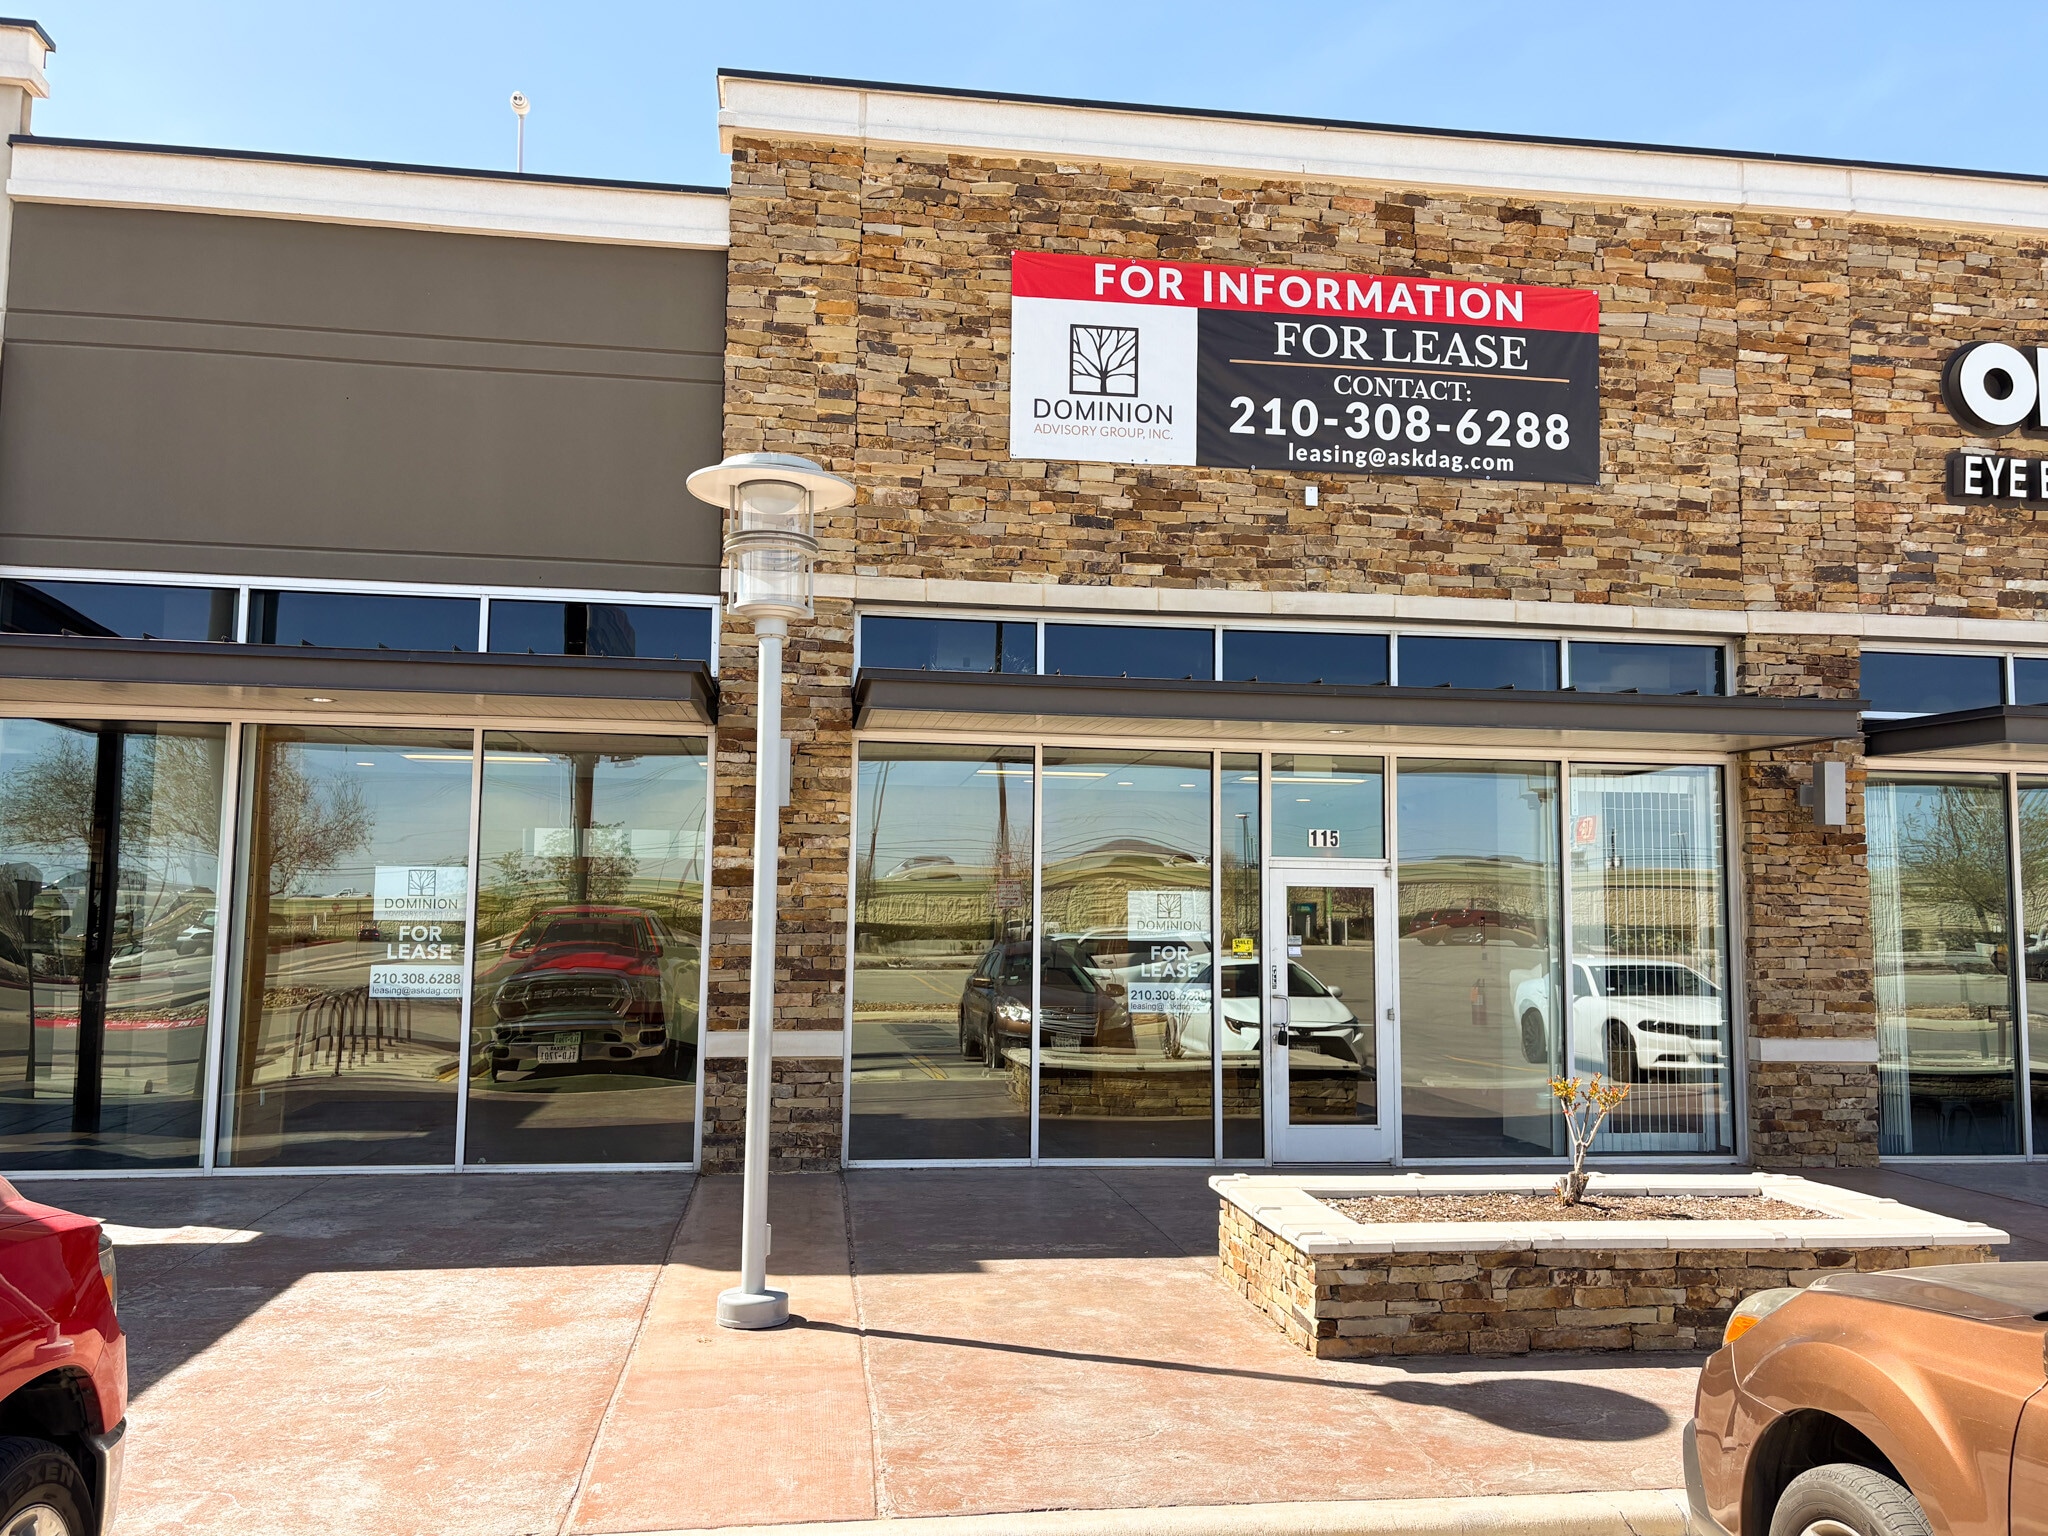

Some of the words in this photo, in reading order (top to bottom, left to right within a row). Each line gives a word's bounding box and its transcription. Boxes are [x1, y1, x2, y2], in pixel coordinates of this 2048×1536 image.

[1094, 263, 1185, 300] FOR
[1203, 270, 1523, 322] INFORMATION
[1273, 321, 1374, 361] FOR
[1381, 328, 1529, 370] LEASE
[1333, 375, 1472, 402] CONTACT:
[1034, 398, 1173, 425] DOMINION
[1034, 423, 1098, 436] ADVISORY
[1100, 426, 1146, 439] GROUP,
[1149, 428, 1174, 440] INC.
[1229, 396, 1570, 450] 210-308-6288
[1288, 442, 1514, 472] leasing@askdag.com
[1964, 455, 2028, 498] EYE
[1310, 830, 1339, 847] 115
[384, 898, 458, 910] DOMINION
[399, 925, 443, 942] FOR
[1137, 920, 1201, 931] DOMINION
[386, 943, 452, 960] LEASE
[1150, 945, 1189, 960] FOR
[373, 973, 461, 984] 210.308.6288
[1141, 962, 1199, 978] LEASE
[372, 986, 461, 996] leasing@askdag.com
